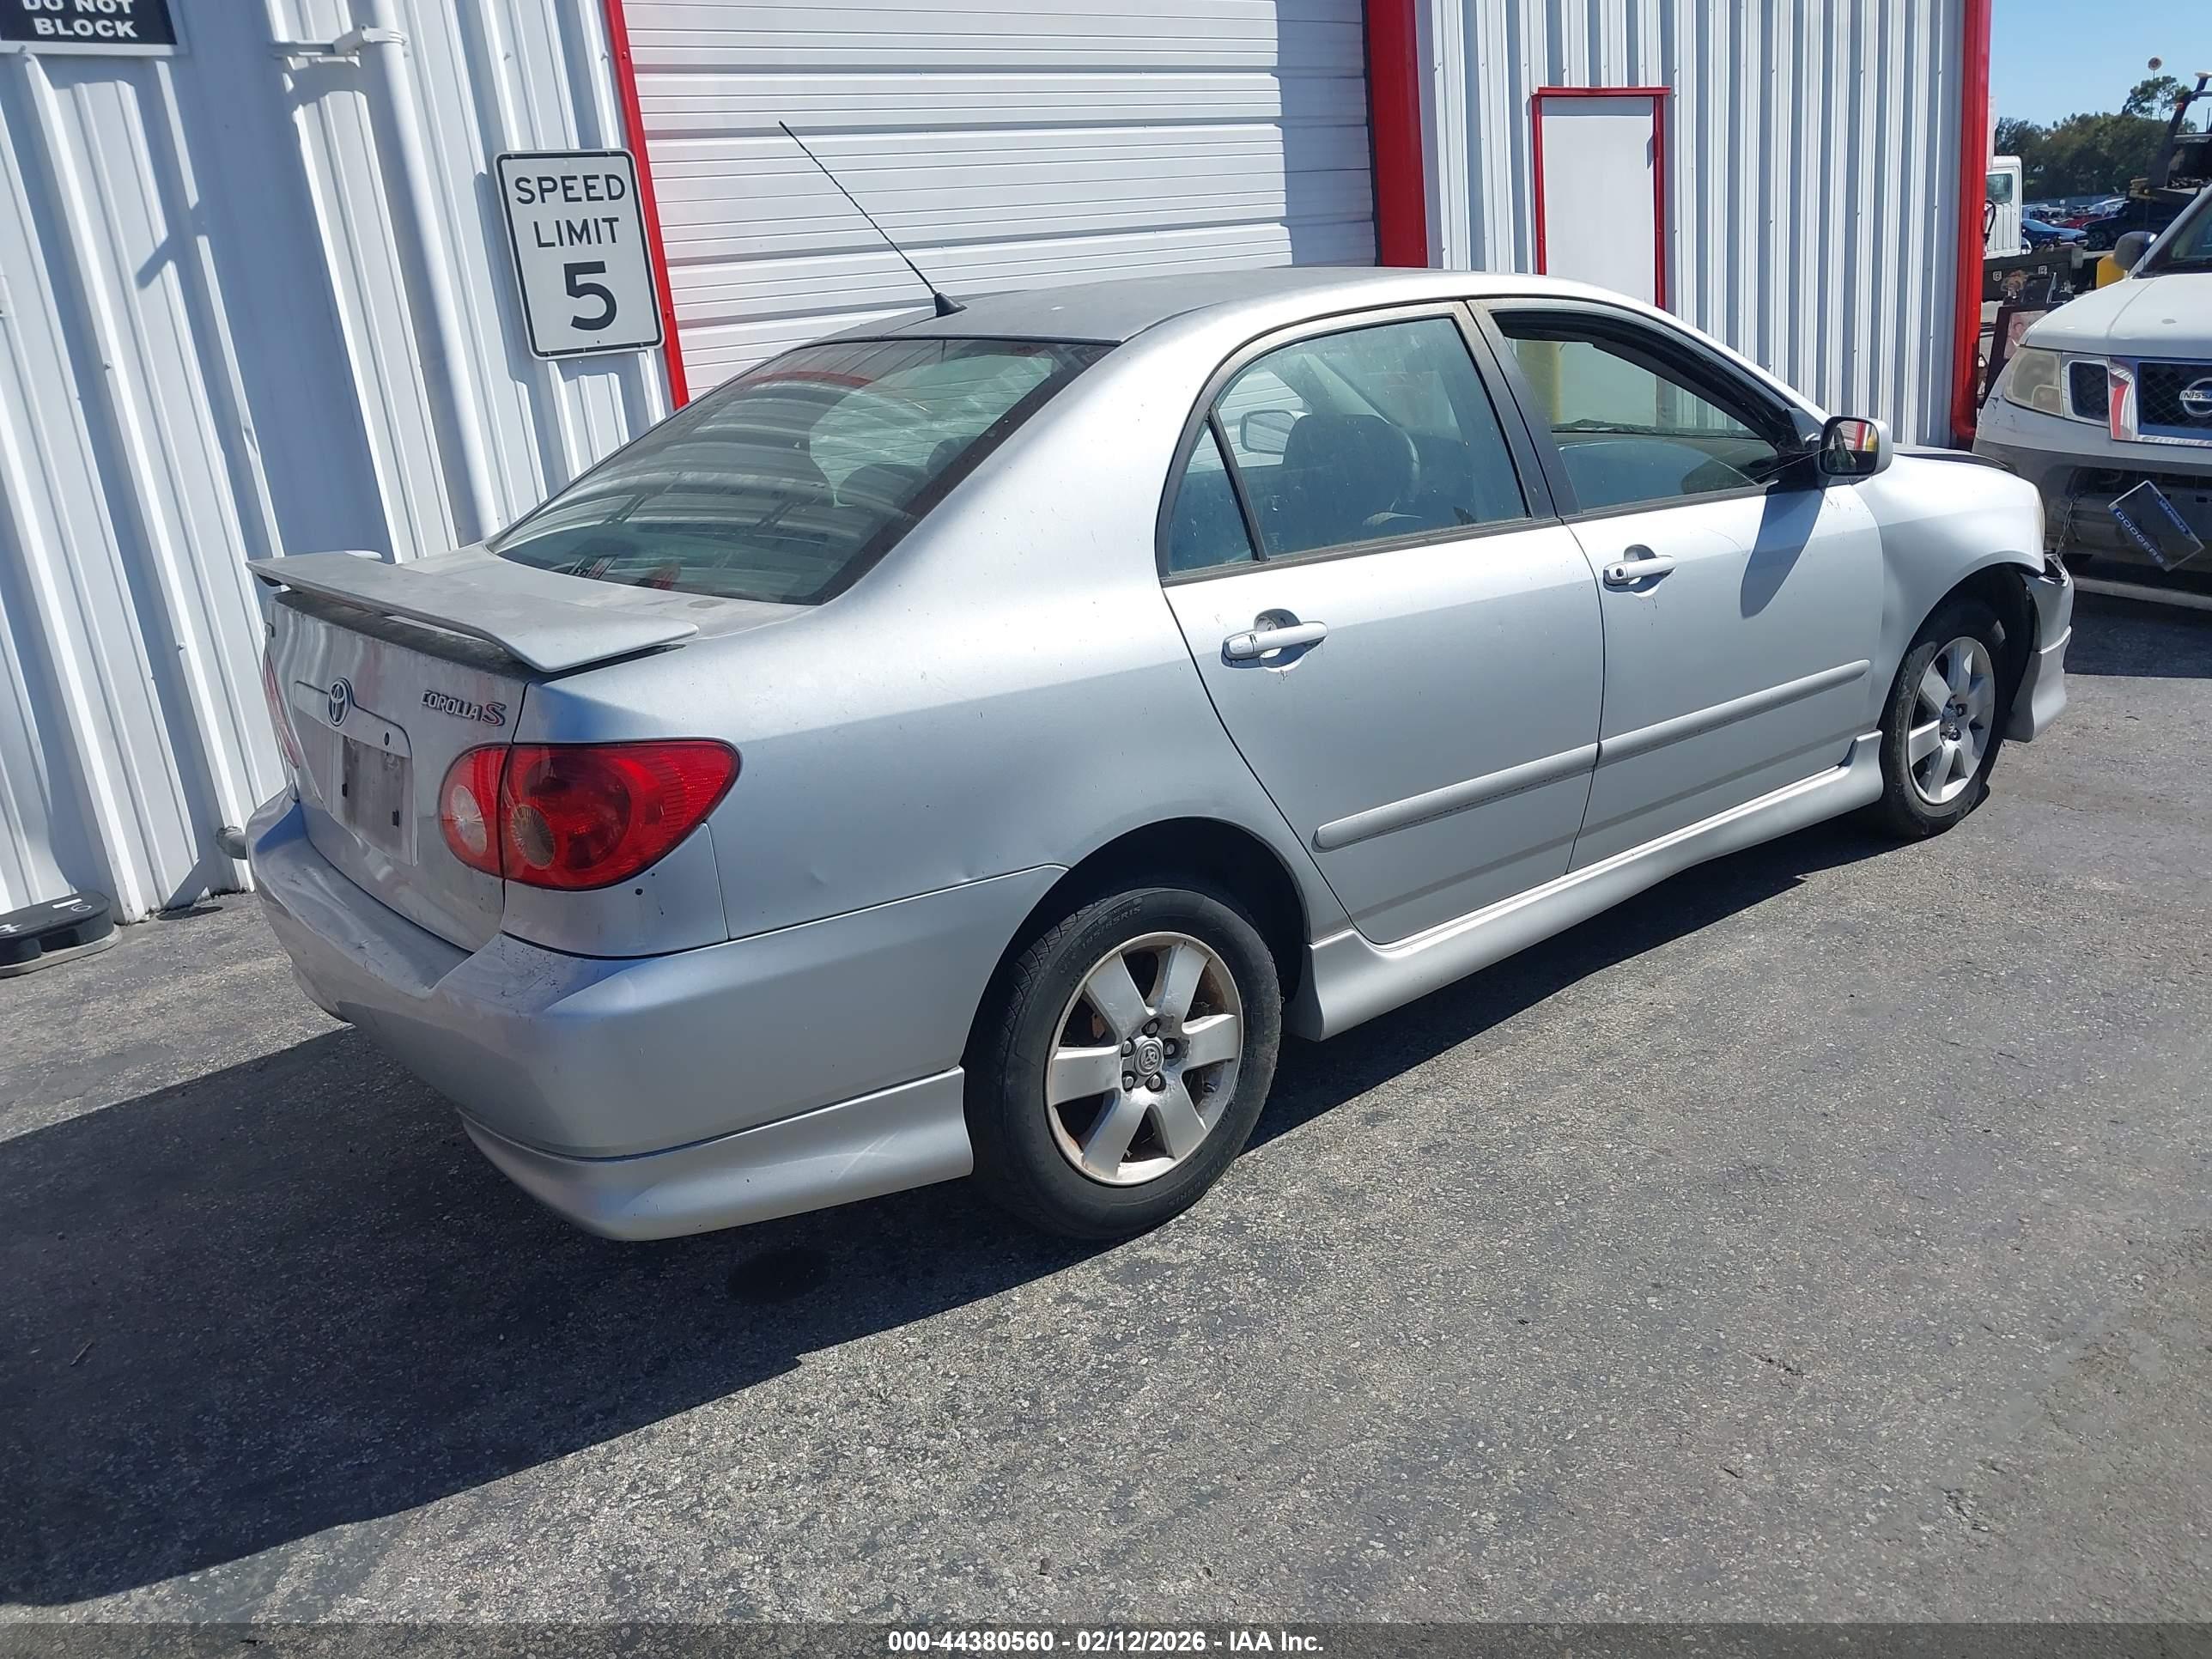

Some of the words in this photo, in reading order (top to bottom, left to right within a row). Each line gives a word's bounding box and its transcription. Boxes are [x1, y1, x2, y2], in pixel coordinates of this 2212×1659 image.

[74, 0, 134, 14] NOT
[33, 17, 139, 38] BLOCK
[515, 173, 626, 204] SPEED
[533, 216, 620, 248] LIMIT
[562, 260, 617, 331] 5
[419, 690, 483, 721] COROLLA
[481, 701, 507, 727] S
